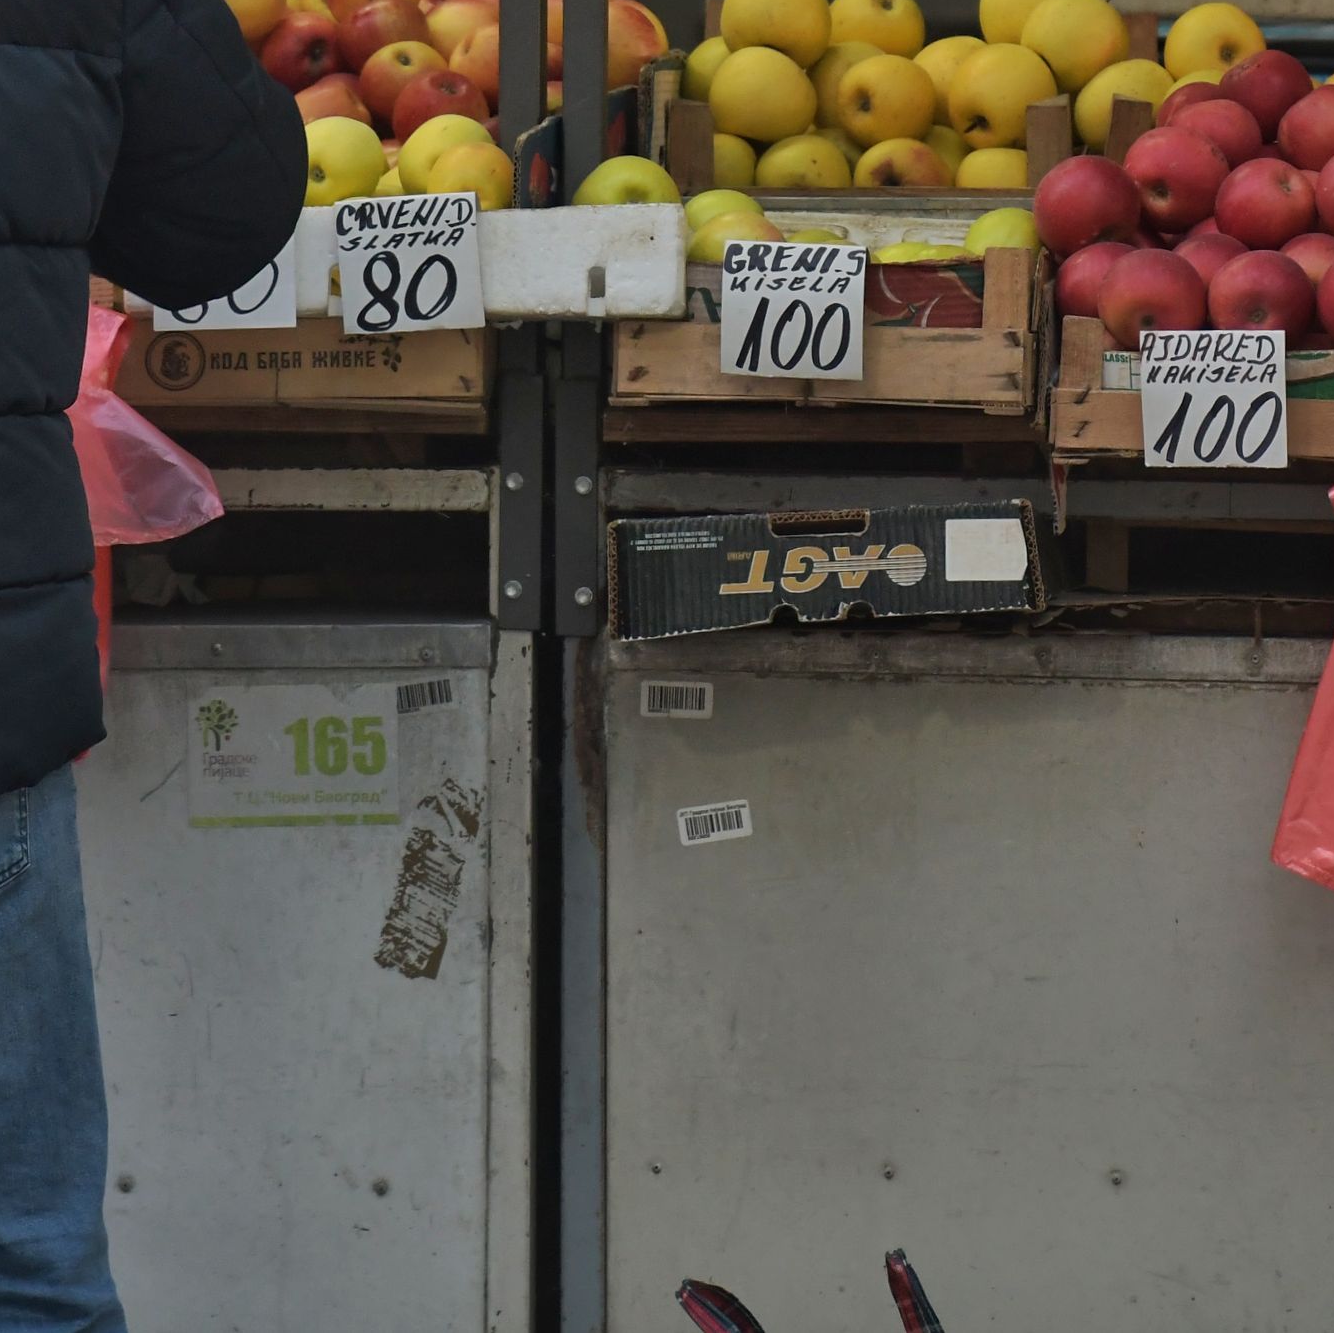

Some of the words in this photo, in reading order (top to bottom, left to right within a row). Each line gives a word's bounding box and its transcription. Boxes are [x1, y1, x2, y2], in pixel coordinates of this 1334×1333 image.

[340, 228, 464, 251] SLATKA
[356, 251, 457, 331] 80
[210, 352, 248, 370] КОД
[257, 351, 302, 369] БАБА
[312, 349, 376, 368] ЖИВКЕ
[735, 297, 850, 372] 100
[1141, 333, 1276, 364] AJDARED
[1153, 391, 1282, 463] 100
[283, 716, 387, 777] 165
